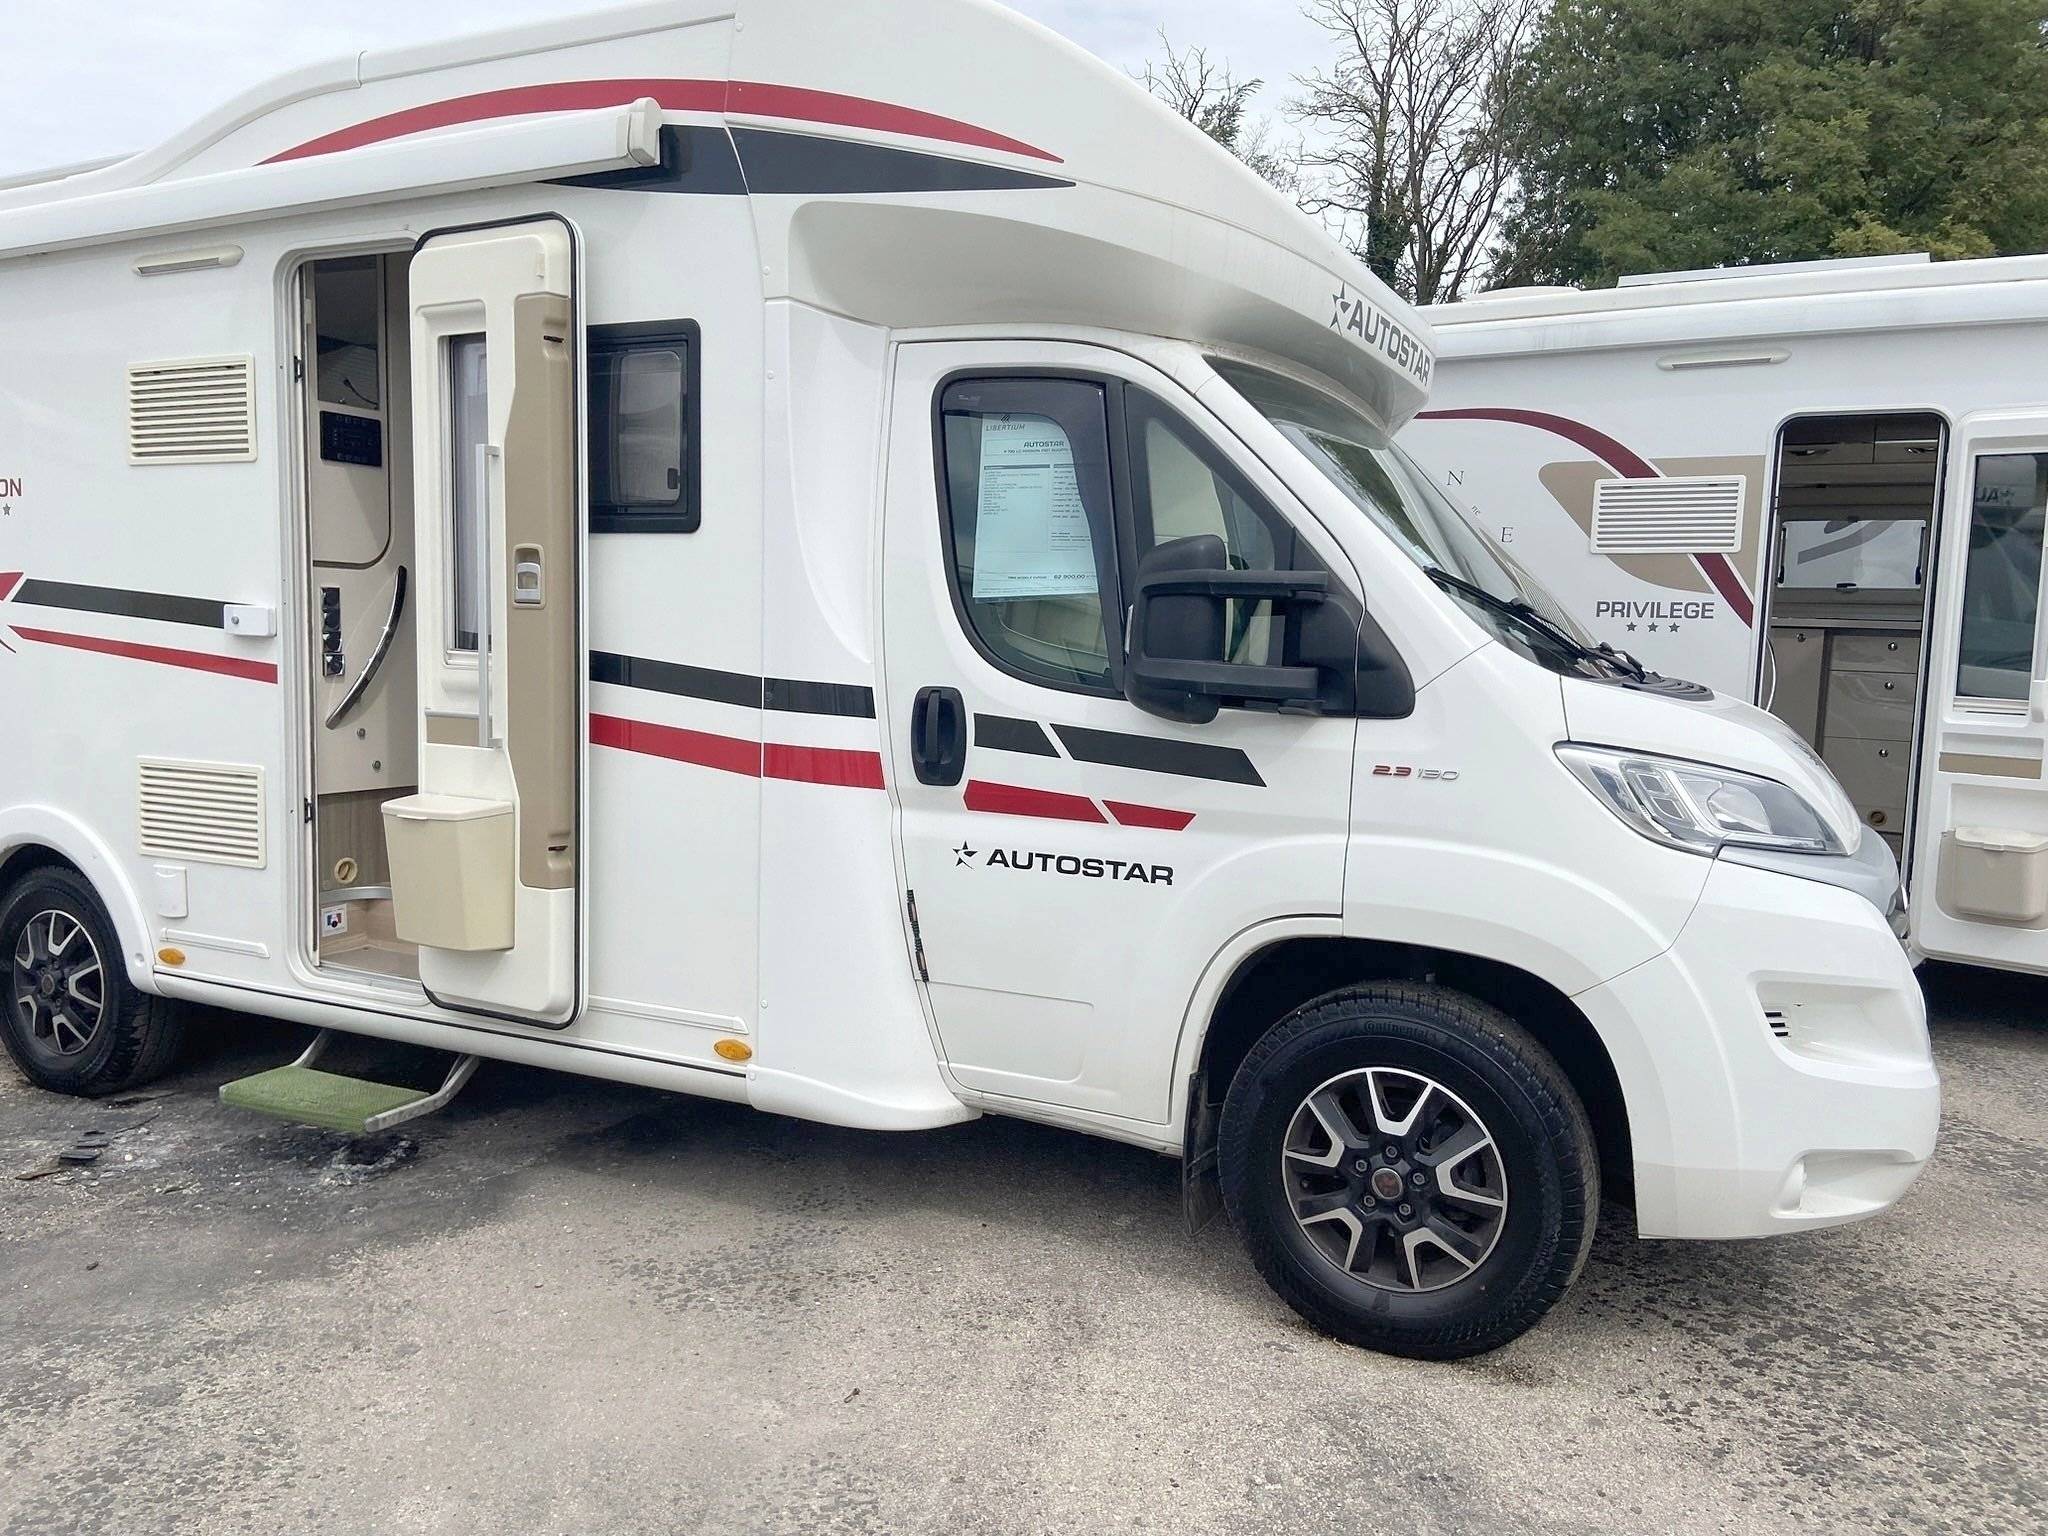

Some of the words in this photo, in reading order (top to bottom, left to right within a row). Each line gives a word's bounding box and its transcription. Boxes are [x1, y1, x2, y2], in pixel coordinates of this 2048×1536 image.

[1347, 299, 1431, 387] AUTOSTAR
[1023, 440, 1065, 448] AUTOSTAR
[1447, 470, 1465, 487] N
[1500, 526, 1514, 544] E
[1595, 600, 1715, 620] PRIVILEGE
[986, 848, 1174, 886] AUTOSTAR
